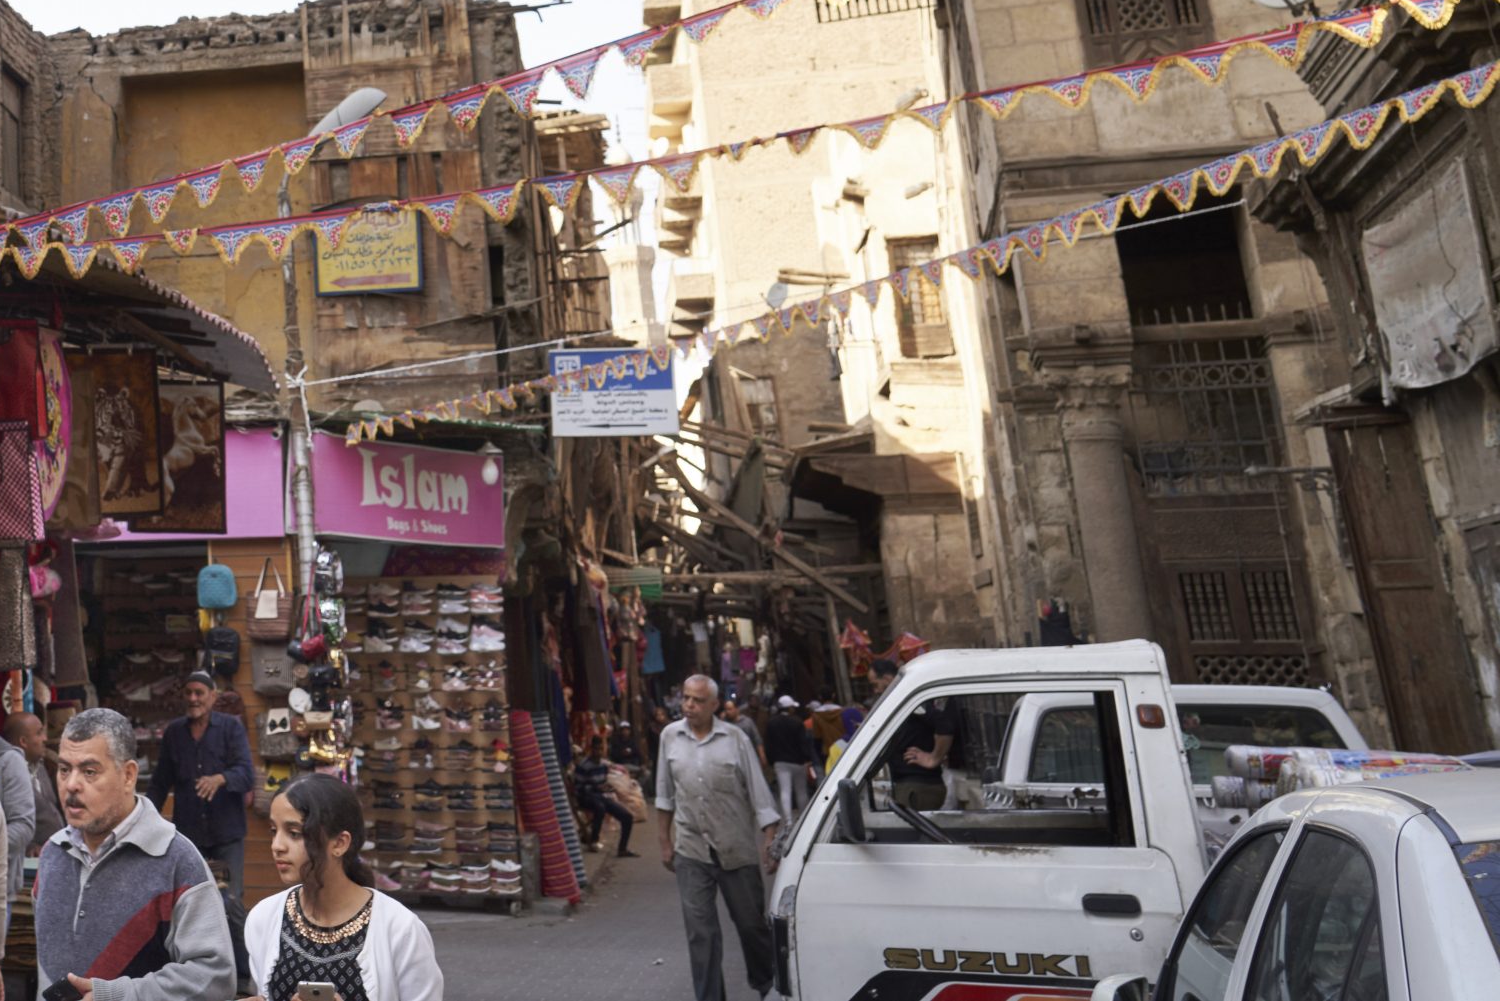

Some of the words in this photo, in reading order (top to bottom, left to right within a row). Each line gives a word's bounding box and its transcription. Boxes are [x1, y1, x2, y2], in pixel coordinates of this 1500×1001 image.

[357, 446, 469, 515] Islam
[387, 516, 410, 535] Bags
[420, 519, 448, 535] Shoes
[883, 947, 1093, 978] SUZUKI
